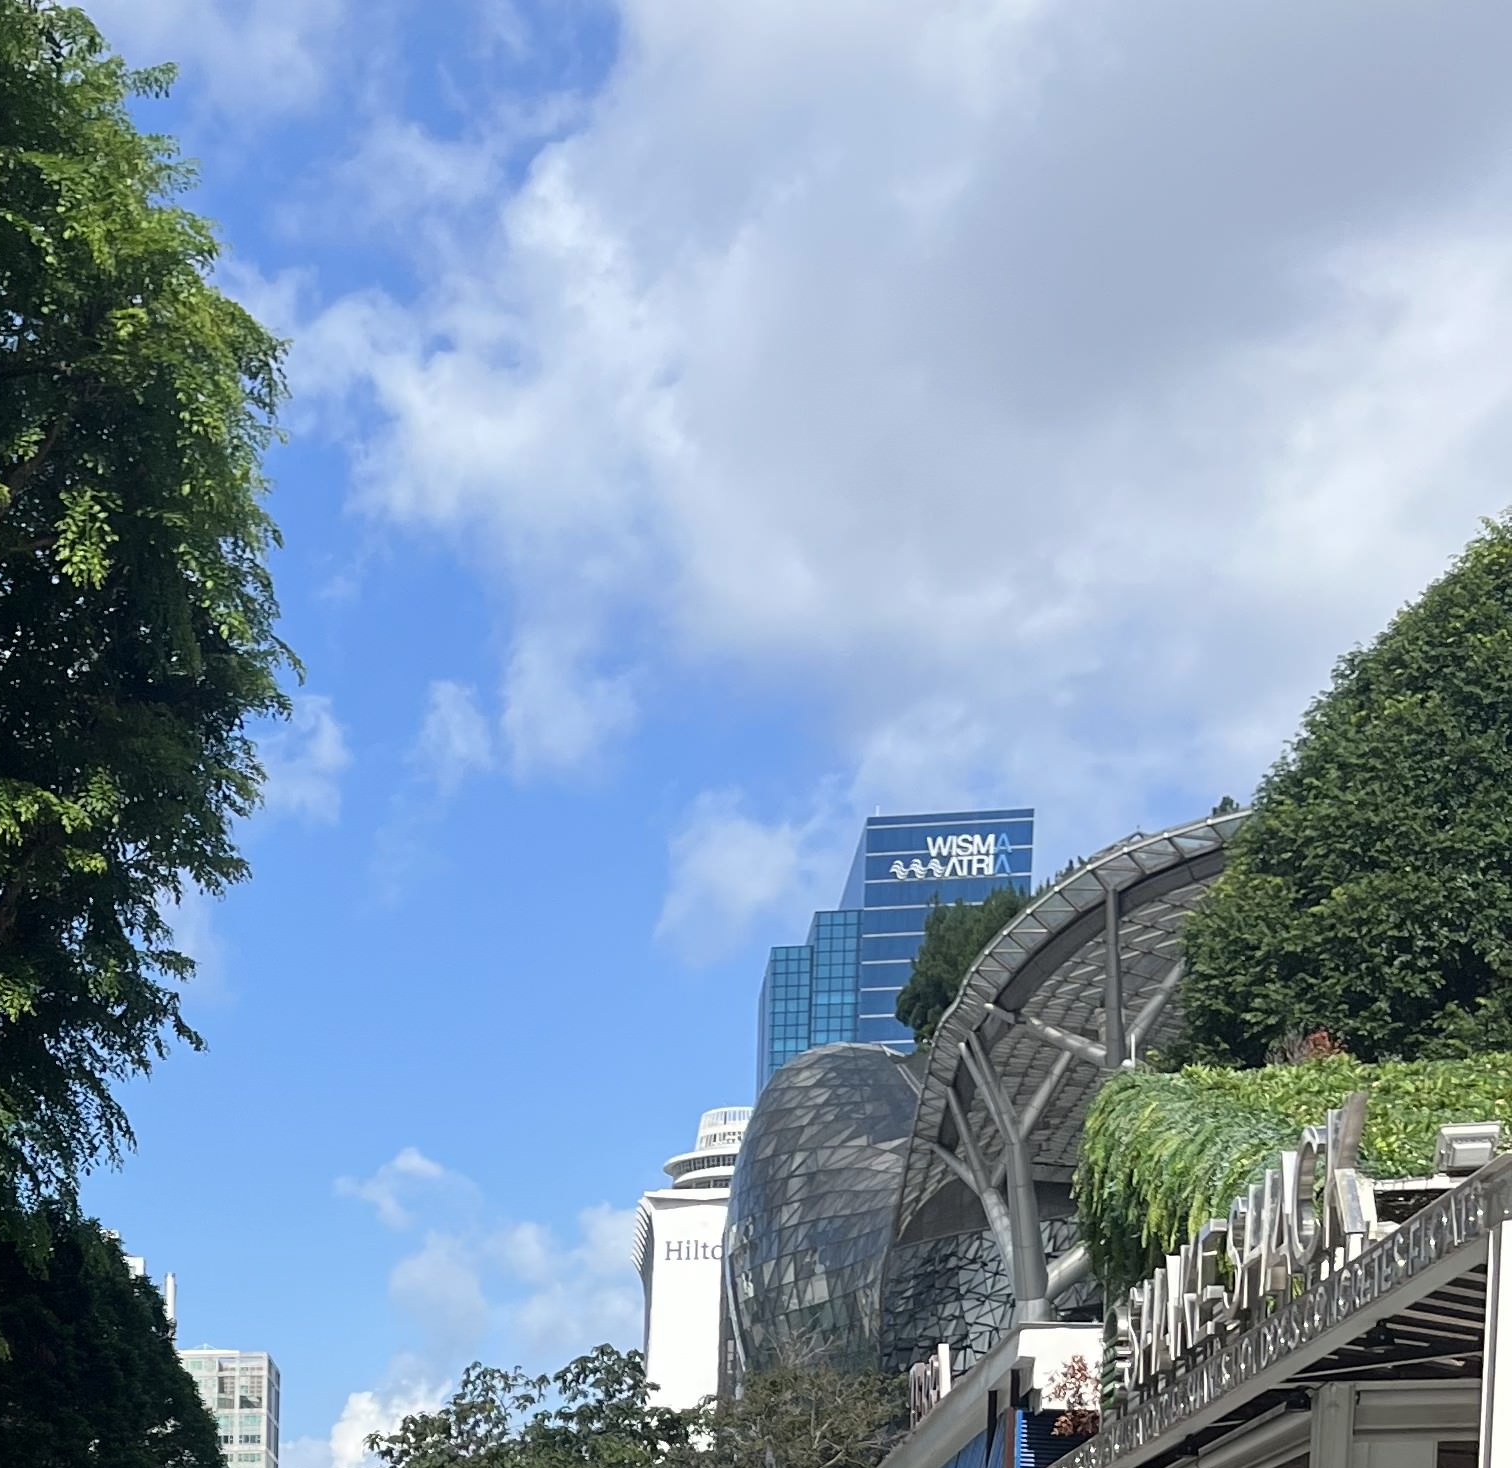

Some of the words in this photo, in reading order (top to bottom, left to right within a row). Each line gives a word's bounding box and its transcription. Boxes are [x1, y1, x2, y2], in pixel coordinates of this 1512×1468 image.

[927, 833, 1011, 857] WISMA
[945, 854, 1011, 877] ATRIA
[1223, 1092, 1374, 1321] SHACK
[665, 1240, 724, 1261] Hilto
